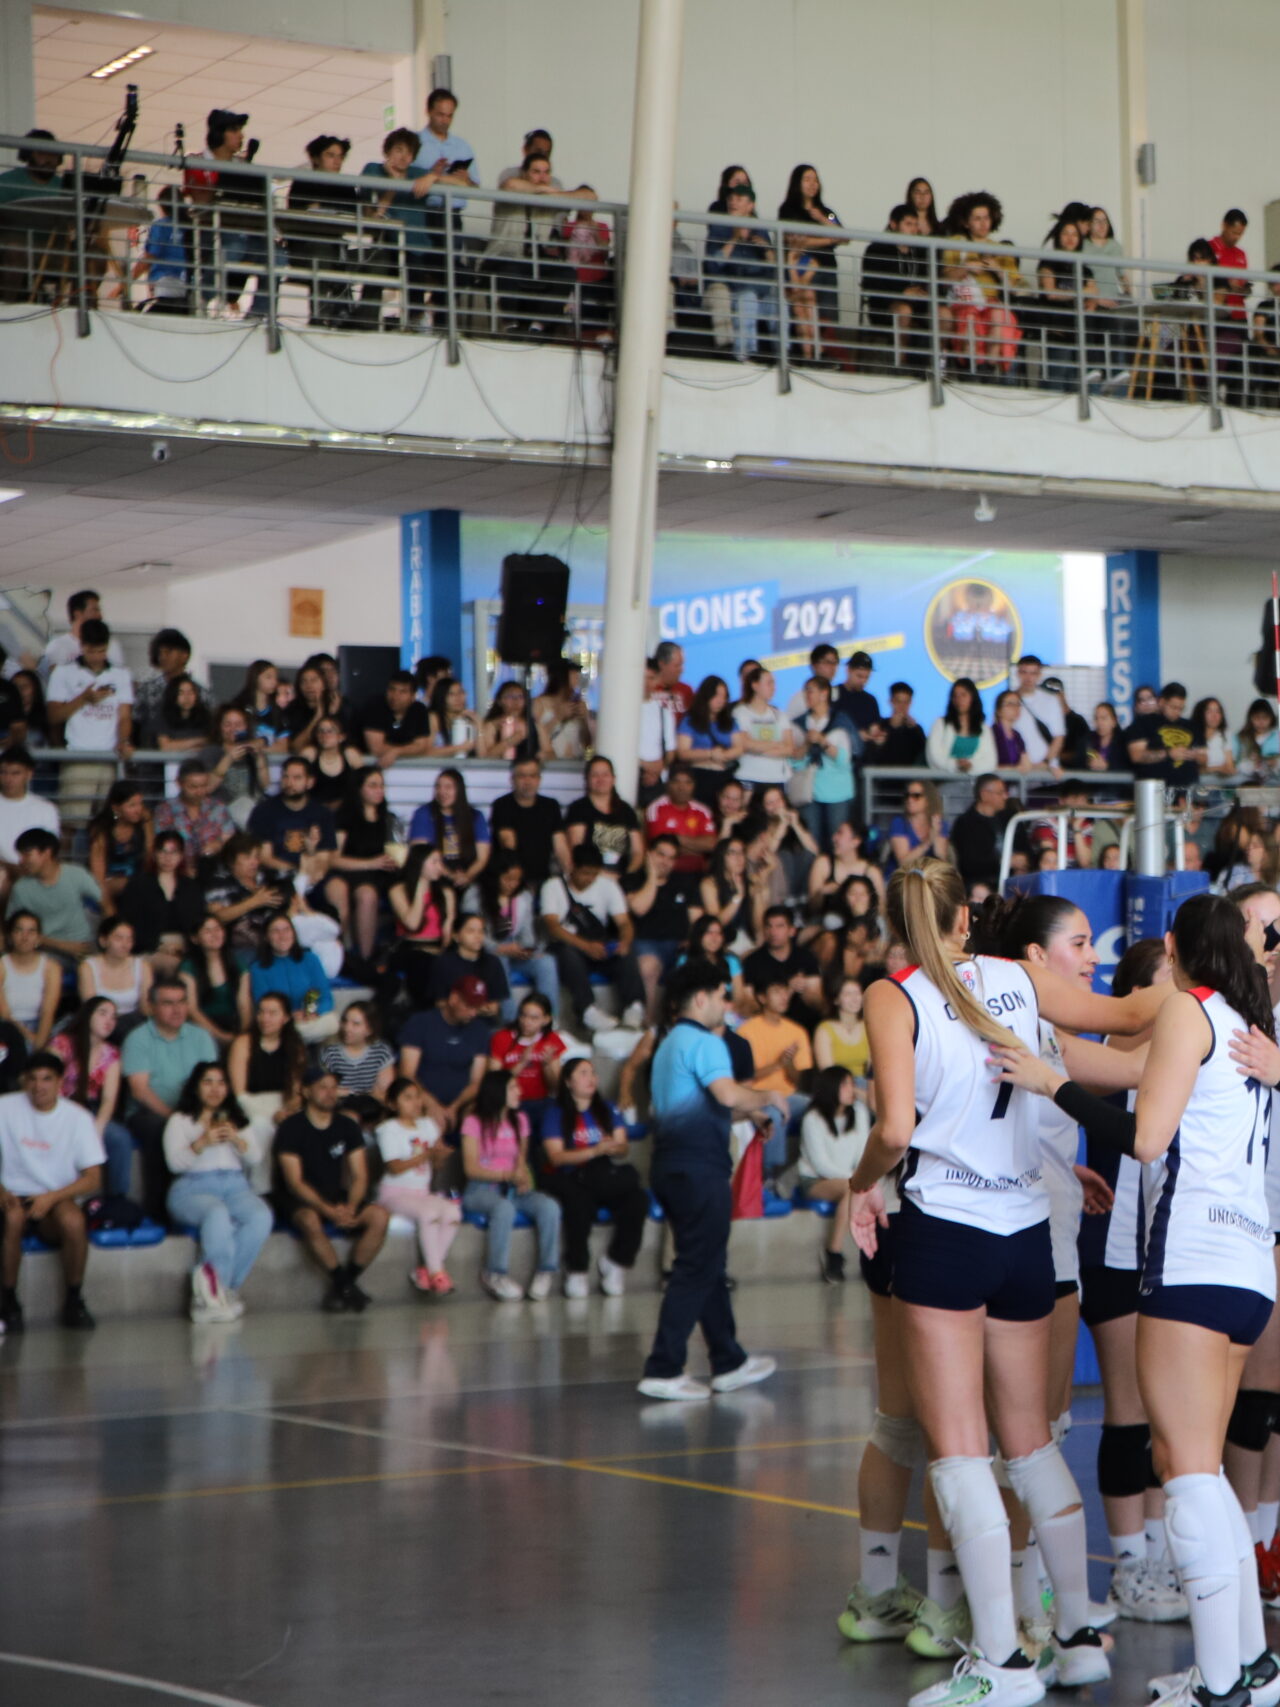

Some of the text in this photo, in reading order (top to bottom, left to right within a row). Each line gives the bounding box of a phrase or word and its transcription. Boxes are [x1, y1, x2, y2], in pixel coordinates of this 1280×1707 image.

[410, 519, 423, 673] TRABAJ
[659, 587, 764, 640] CIONES
[782, 596, 855, 641] 2024
[944, 990, 1027, 1021] CSON
